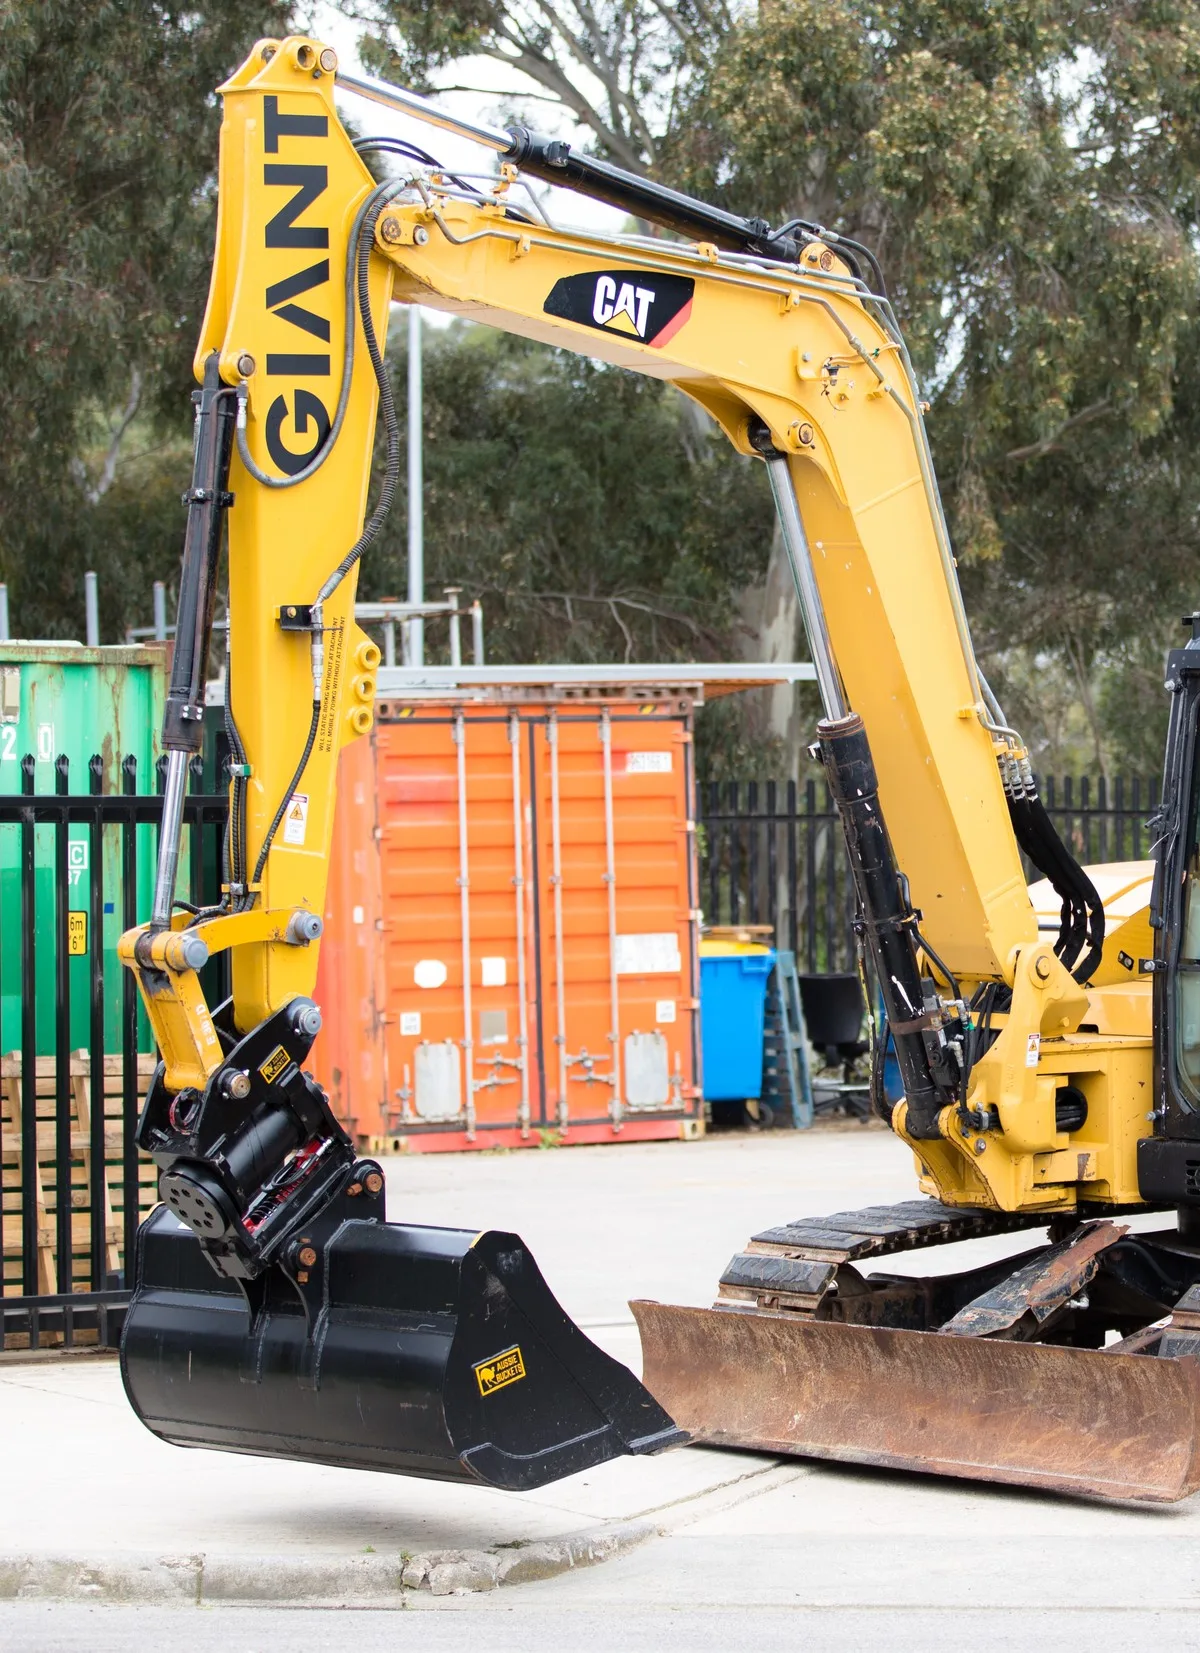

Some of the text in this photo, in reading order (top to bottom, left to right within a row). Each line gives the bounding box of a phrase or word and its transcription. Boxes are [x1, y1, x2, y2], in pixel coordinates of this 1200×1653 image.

[263, 95, 332, 477] GIANT
[593, 275, 656, 338] CAT
[328, 616, 339, 661] ATTACHMNT
[325, 661, 333, 691] WITHOUT
[327, 712, 335, 737] MOBILE
[333, 660, 341, 689] WITHOUT
[320, 713, 328, 736] STATIC
[495, 1363, 523, 1383] BUCKETS
[496, 1354, 518, 1372] AUSSIE
